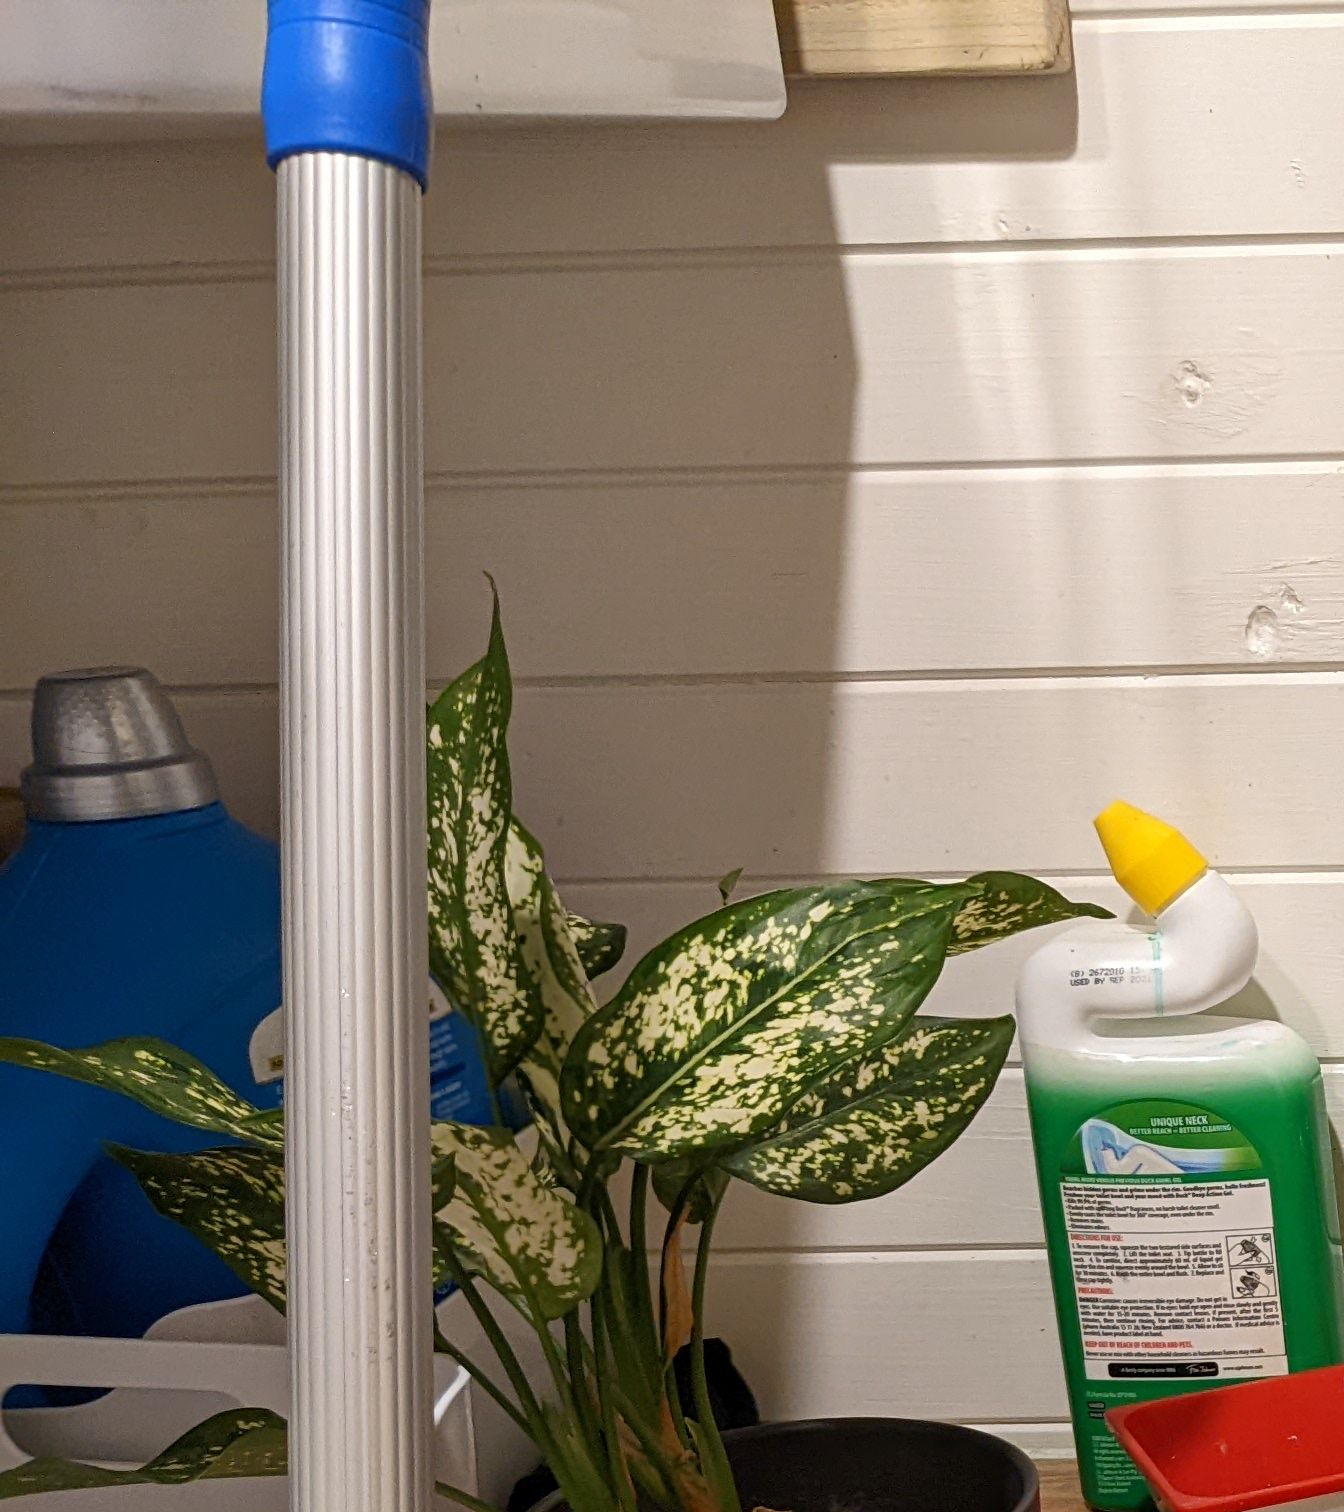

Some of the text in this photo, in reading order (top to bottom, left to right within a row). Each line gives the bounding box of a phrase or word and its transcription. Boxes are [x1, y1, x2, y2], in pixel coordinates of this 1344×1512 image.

[1070, 978, 1090, 986] USED
[1150, 1115, 1208, 1128] UNIQUE NECK
[1129, 1127, 1152, 1135] BETTER
[1152, 1126, 1172, 1134] REACH
[1178, 1126, 1202, 1134] BETTER
[1202, 1124, 1232, 1132] CLEANING
